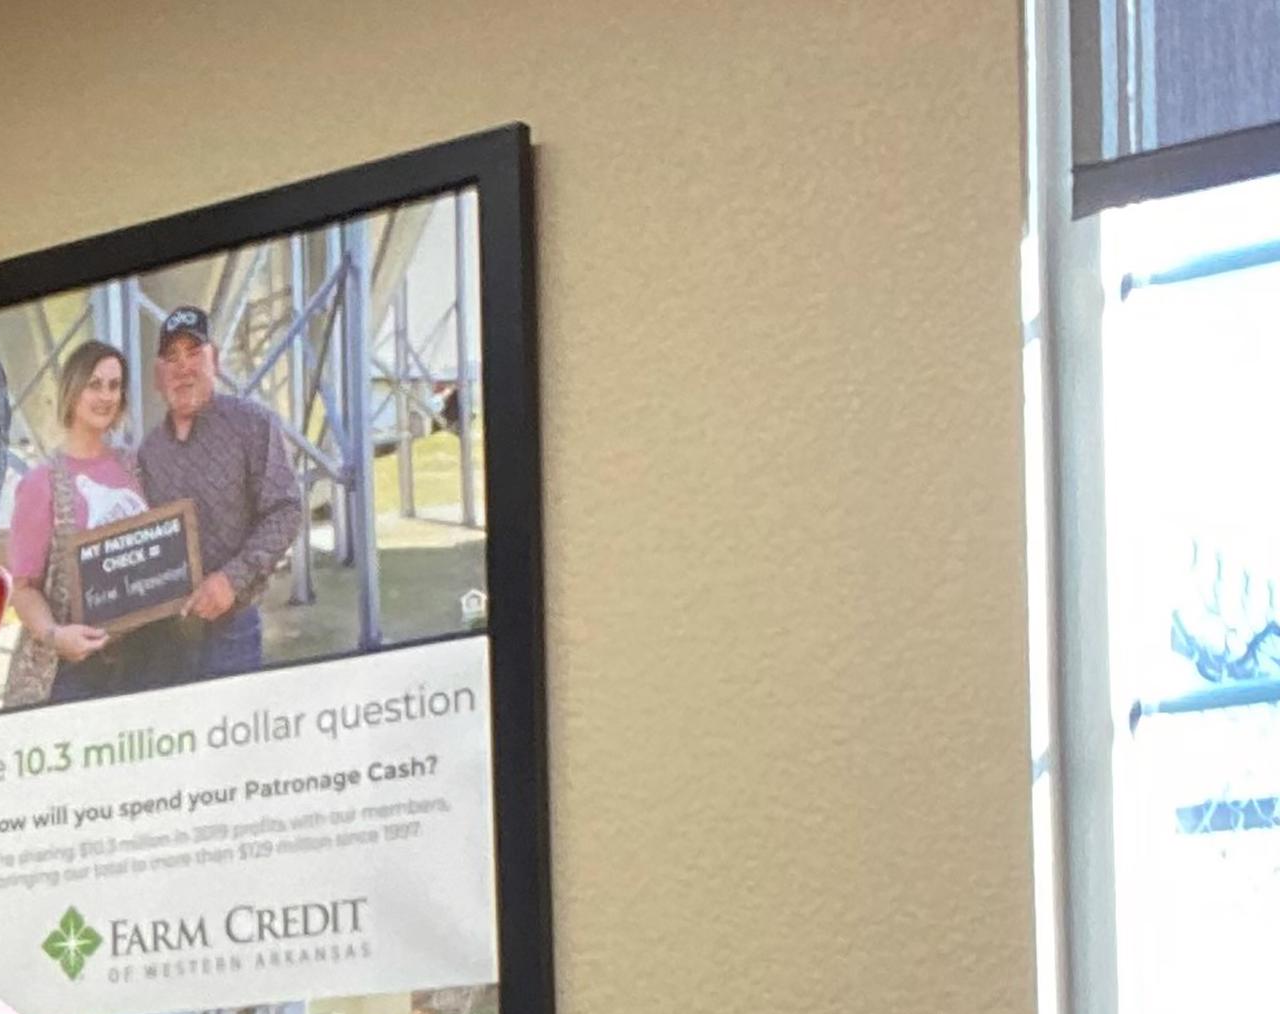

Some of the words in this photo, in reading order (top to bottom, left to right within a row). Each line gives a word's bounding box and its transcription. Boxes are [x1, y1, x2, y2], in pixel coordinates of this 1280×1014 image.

[80, 543, 102, 561] MY
[13, 740, 71, 778] 10.3
[83, 727, 196, 769] million
[207, 708, 307, 749] dollar
[316, 682, 476, 740] question
[32, 805, 69, 828] will
[74, 805, 113, 828] you
[119, 790, 183, 821] spend
[188, 785, 238, 812] your
[245, 767, 362, 801] Patronage
[367, 755, 439, 782] Cash?
[109, 915, 212, 957] FARM
[224, 897, 368, 944] CREDIT
[108, 965, 133, 984] OF
[144, 955, 242, 980] WESTERN
[255, 941, 373, 969] ARKANSAS
